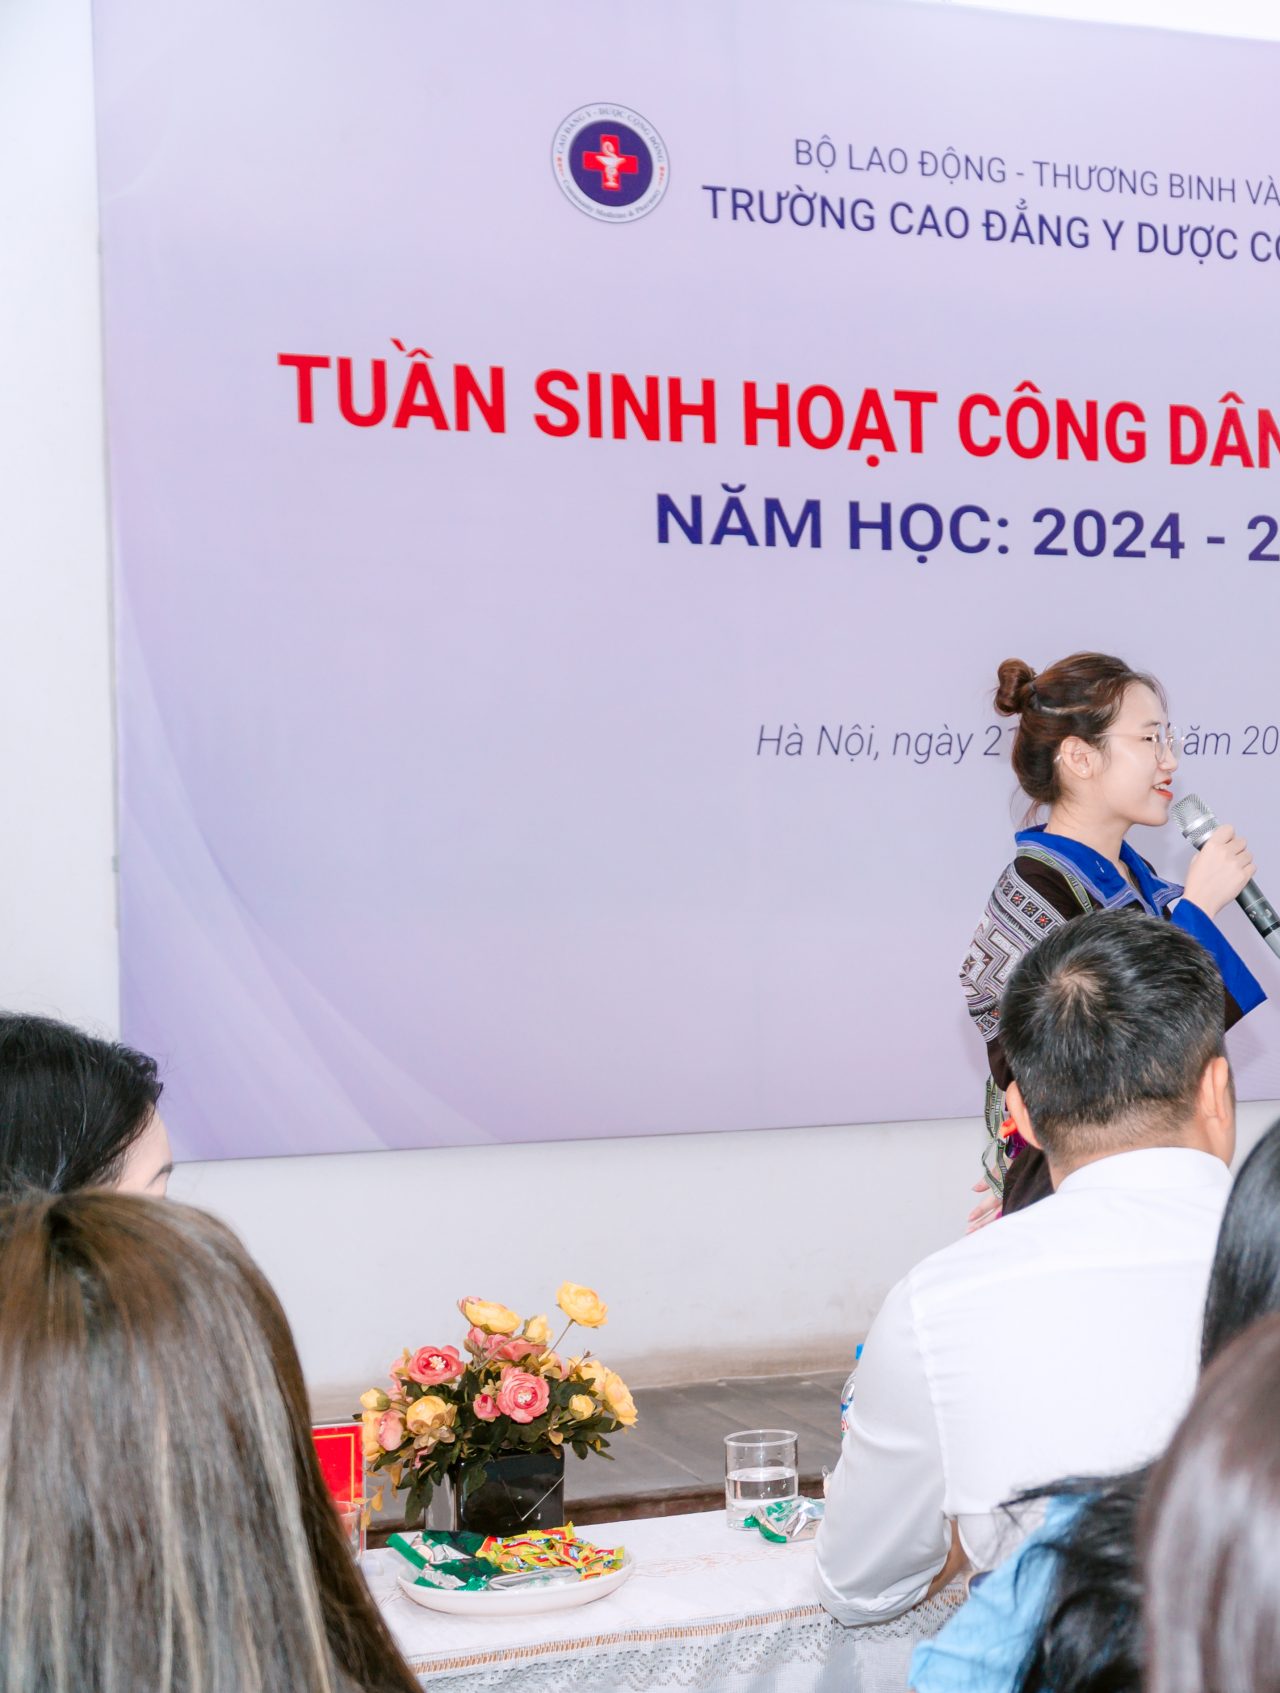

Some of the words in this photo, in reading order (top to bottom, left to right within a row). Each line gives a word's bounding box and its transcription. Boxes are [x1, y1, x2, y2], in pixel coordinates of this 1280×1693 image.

[795, 134, 836, 174] BỘ
[848, 144, 908, 175] LAO
[917, 146, 1006, 184] ĐỘNG
[1032, 160, 1158, 197] THƯƠNG
[1169, 173, 1236, 203] BINH
[701, 184, 875, 232] TRƯỜNG
[890, 201, 970, 239] CAO
[981, 198, 1090, 249] ĐẲNG
[1102, 219, 1124, 251] Y
[1137, 222, 1238, 265] DƯỢC
[277, 338, 506, 434] TUẦN
[534, 369, 717, 444] SINH
[743, 381, 938, 467] HOẠT
[958, 380, 1146, 464] CÔNG
[657, 483, 821, 548] NĂM
[849, 501, 1009, 564] HỌC:
[1033, 508, 1185, 559] 2024
[1206, 535, 1226, 545] -
[757, 723, 804, 756] Hà
[817, 723, 879, 762] Nội,
[892, 723, 974, 765] ngày
[1182, 725, 1231, 756] ăm
